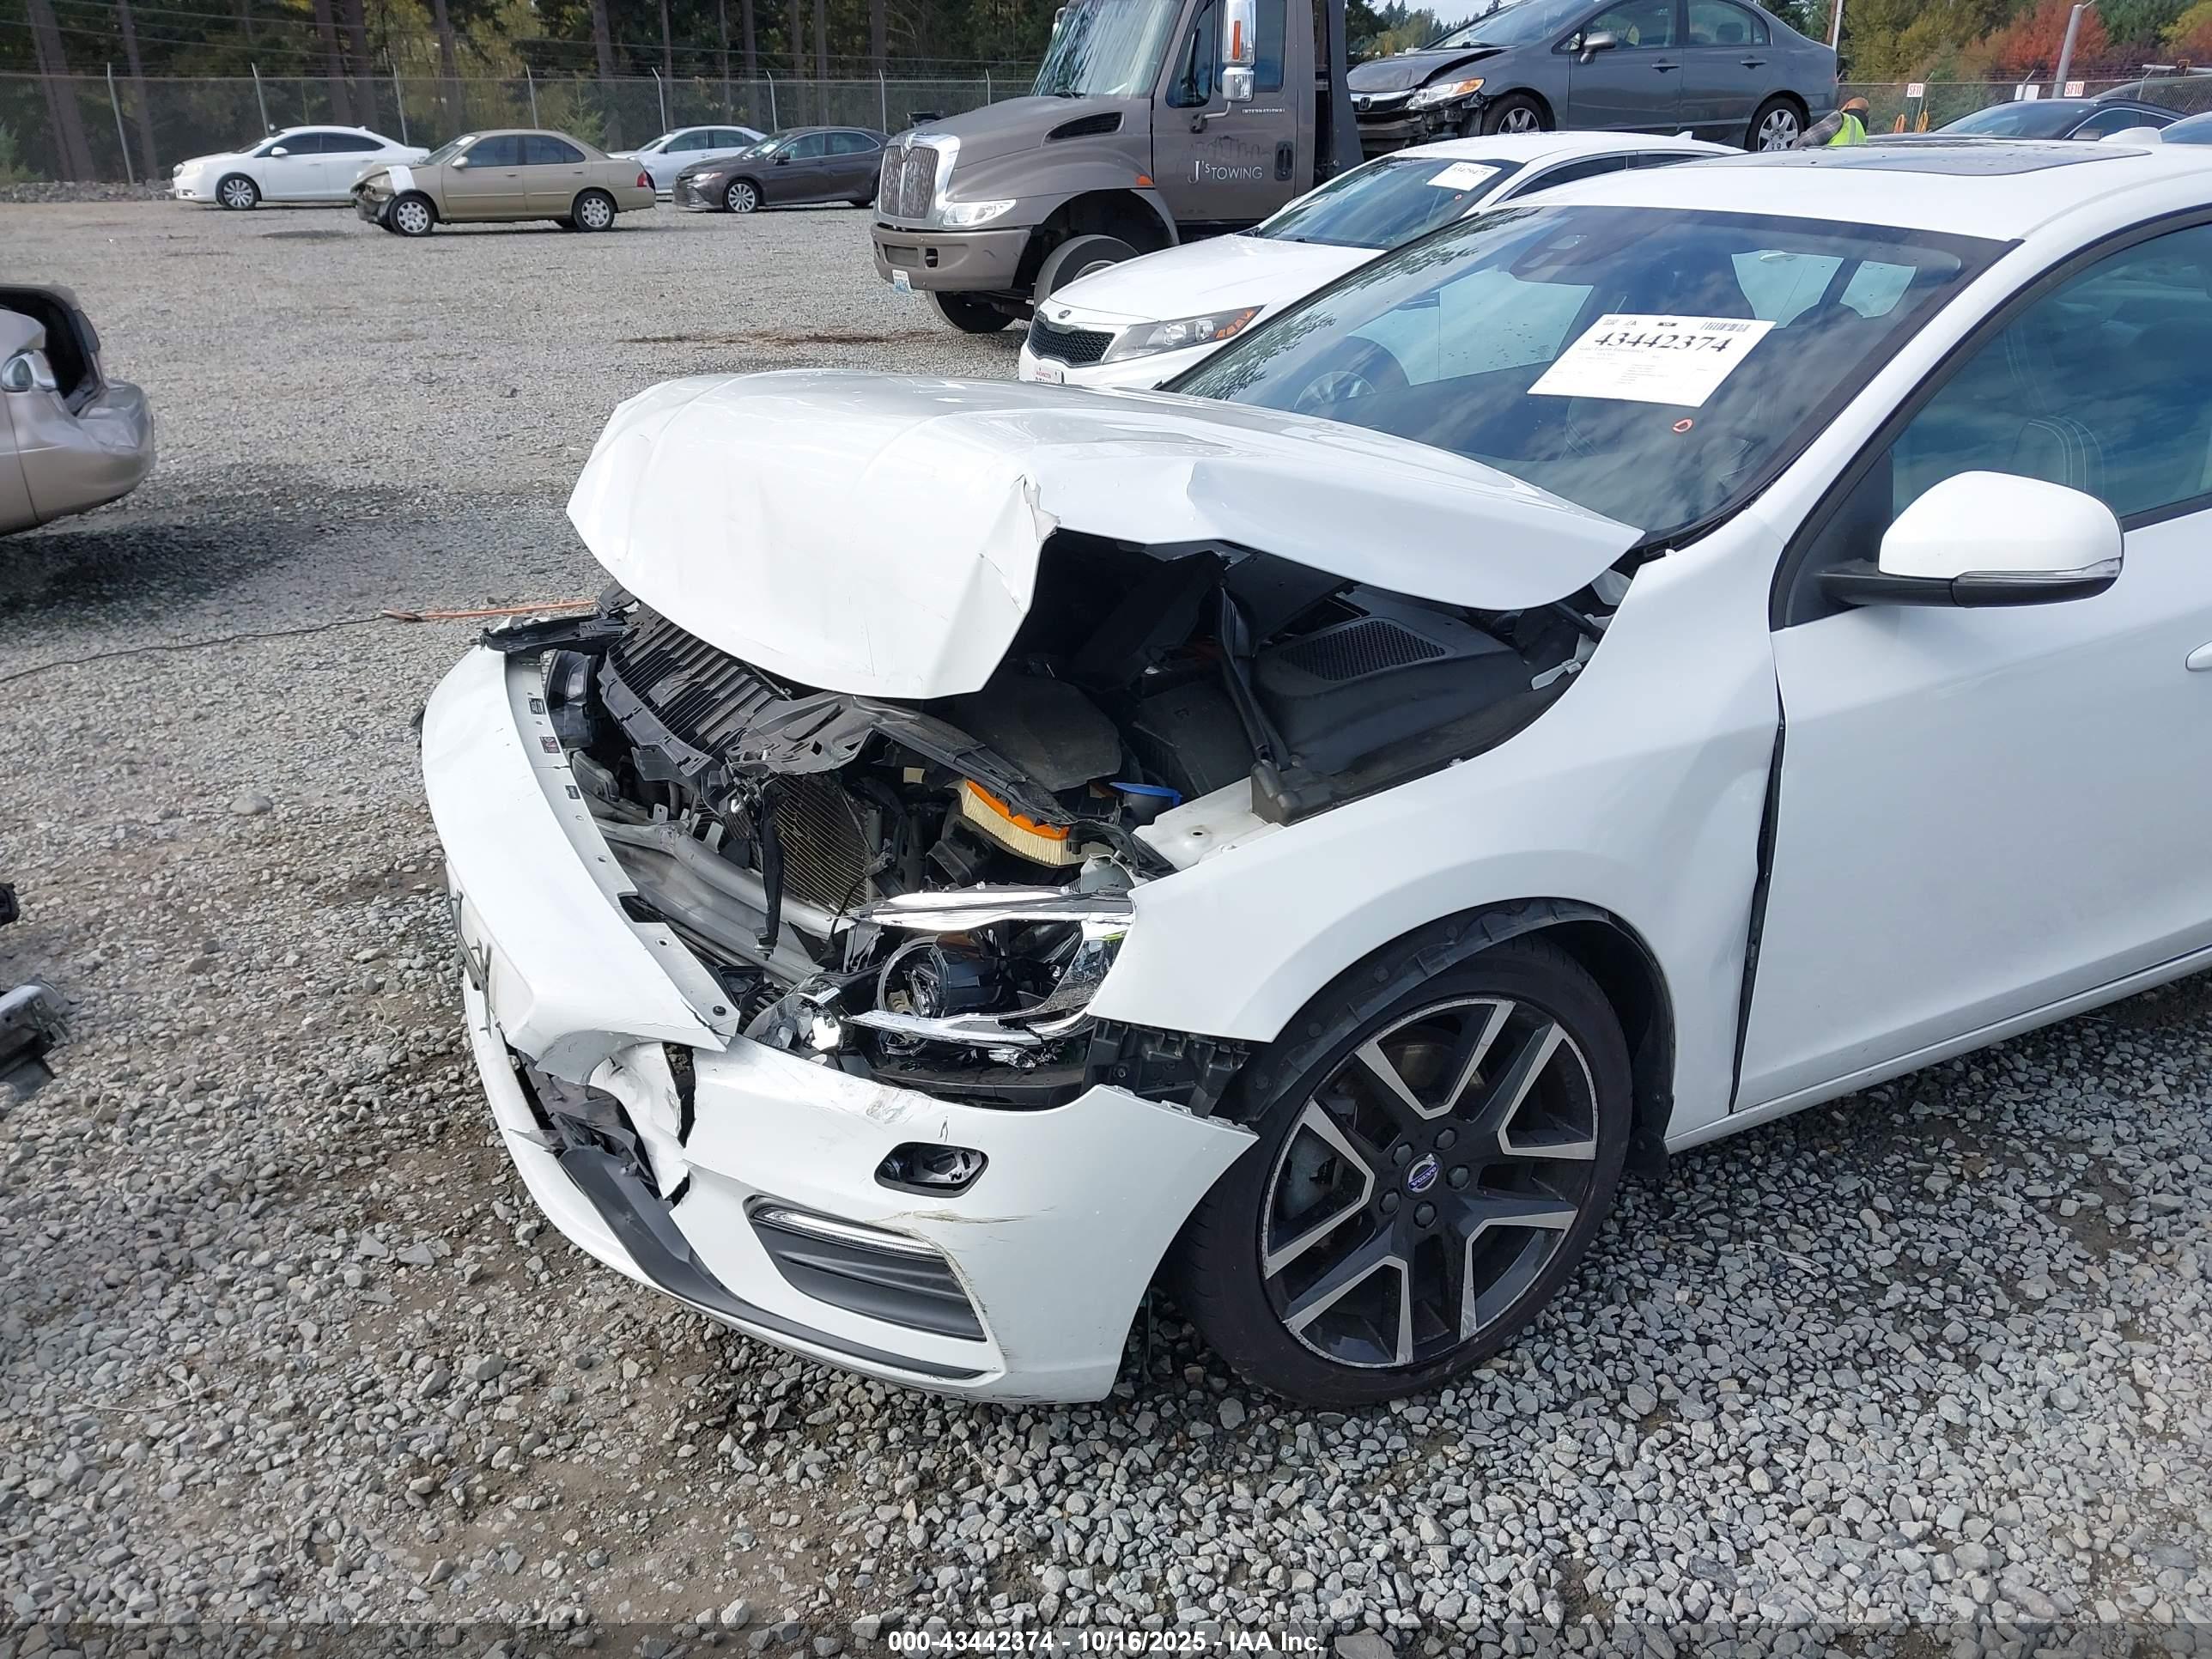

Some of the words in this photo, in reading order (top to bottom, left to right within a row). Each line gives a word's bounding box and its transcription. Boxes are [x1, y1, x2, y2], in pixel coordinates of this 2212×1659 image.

[1908, 85, 1922, 95] SF11
[2066, 83, 2083, 94] SF10
[1211, 167, 1263, 179] TOWING
[1595, 332, 1733, 352] 43442374
[1411, 1166, 1437, 1186] VOLVO
